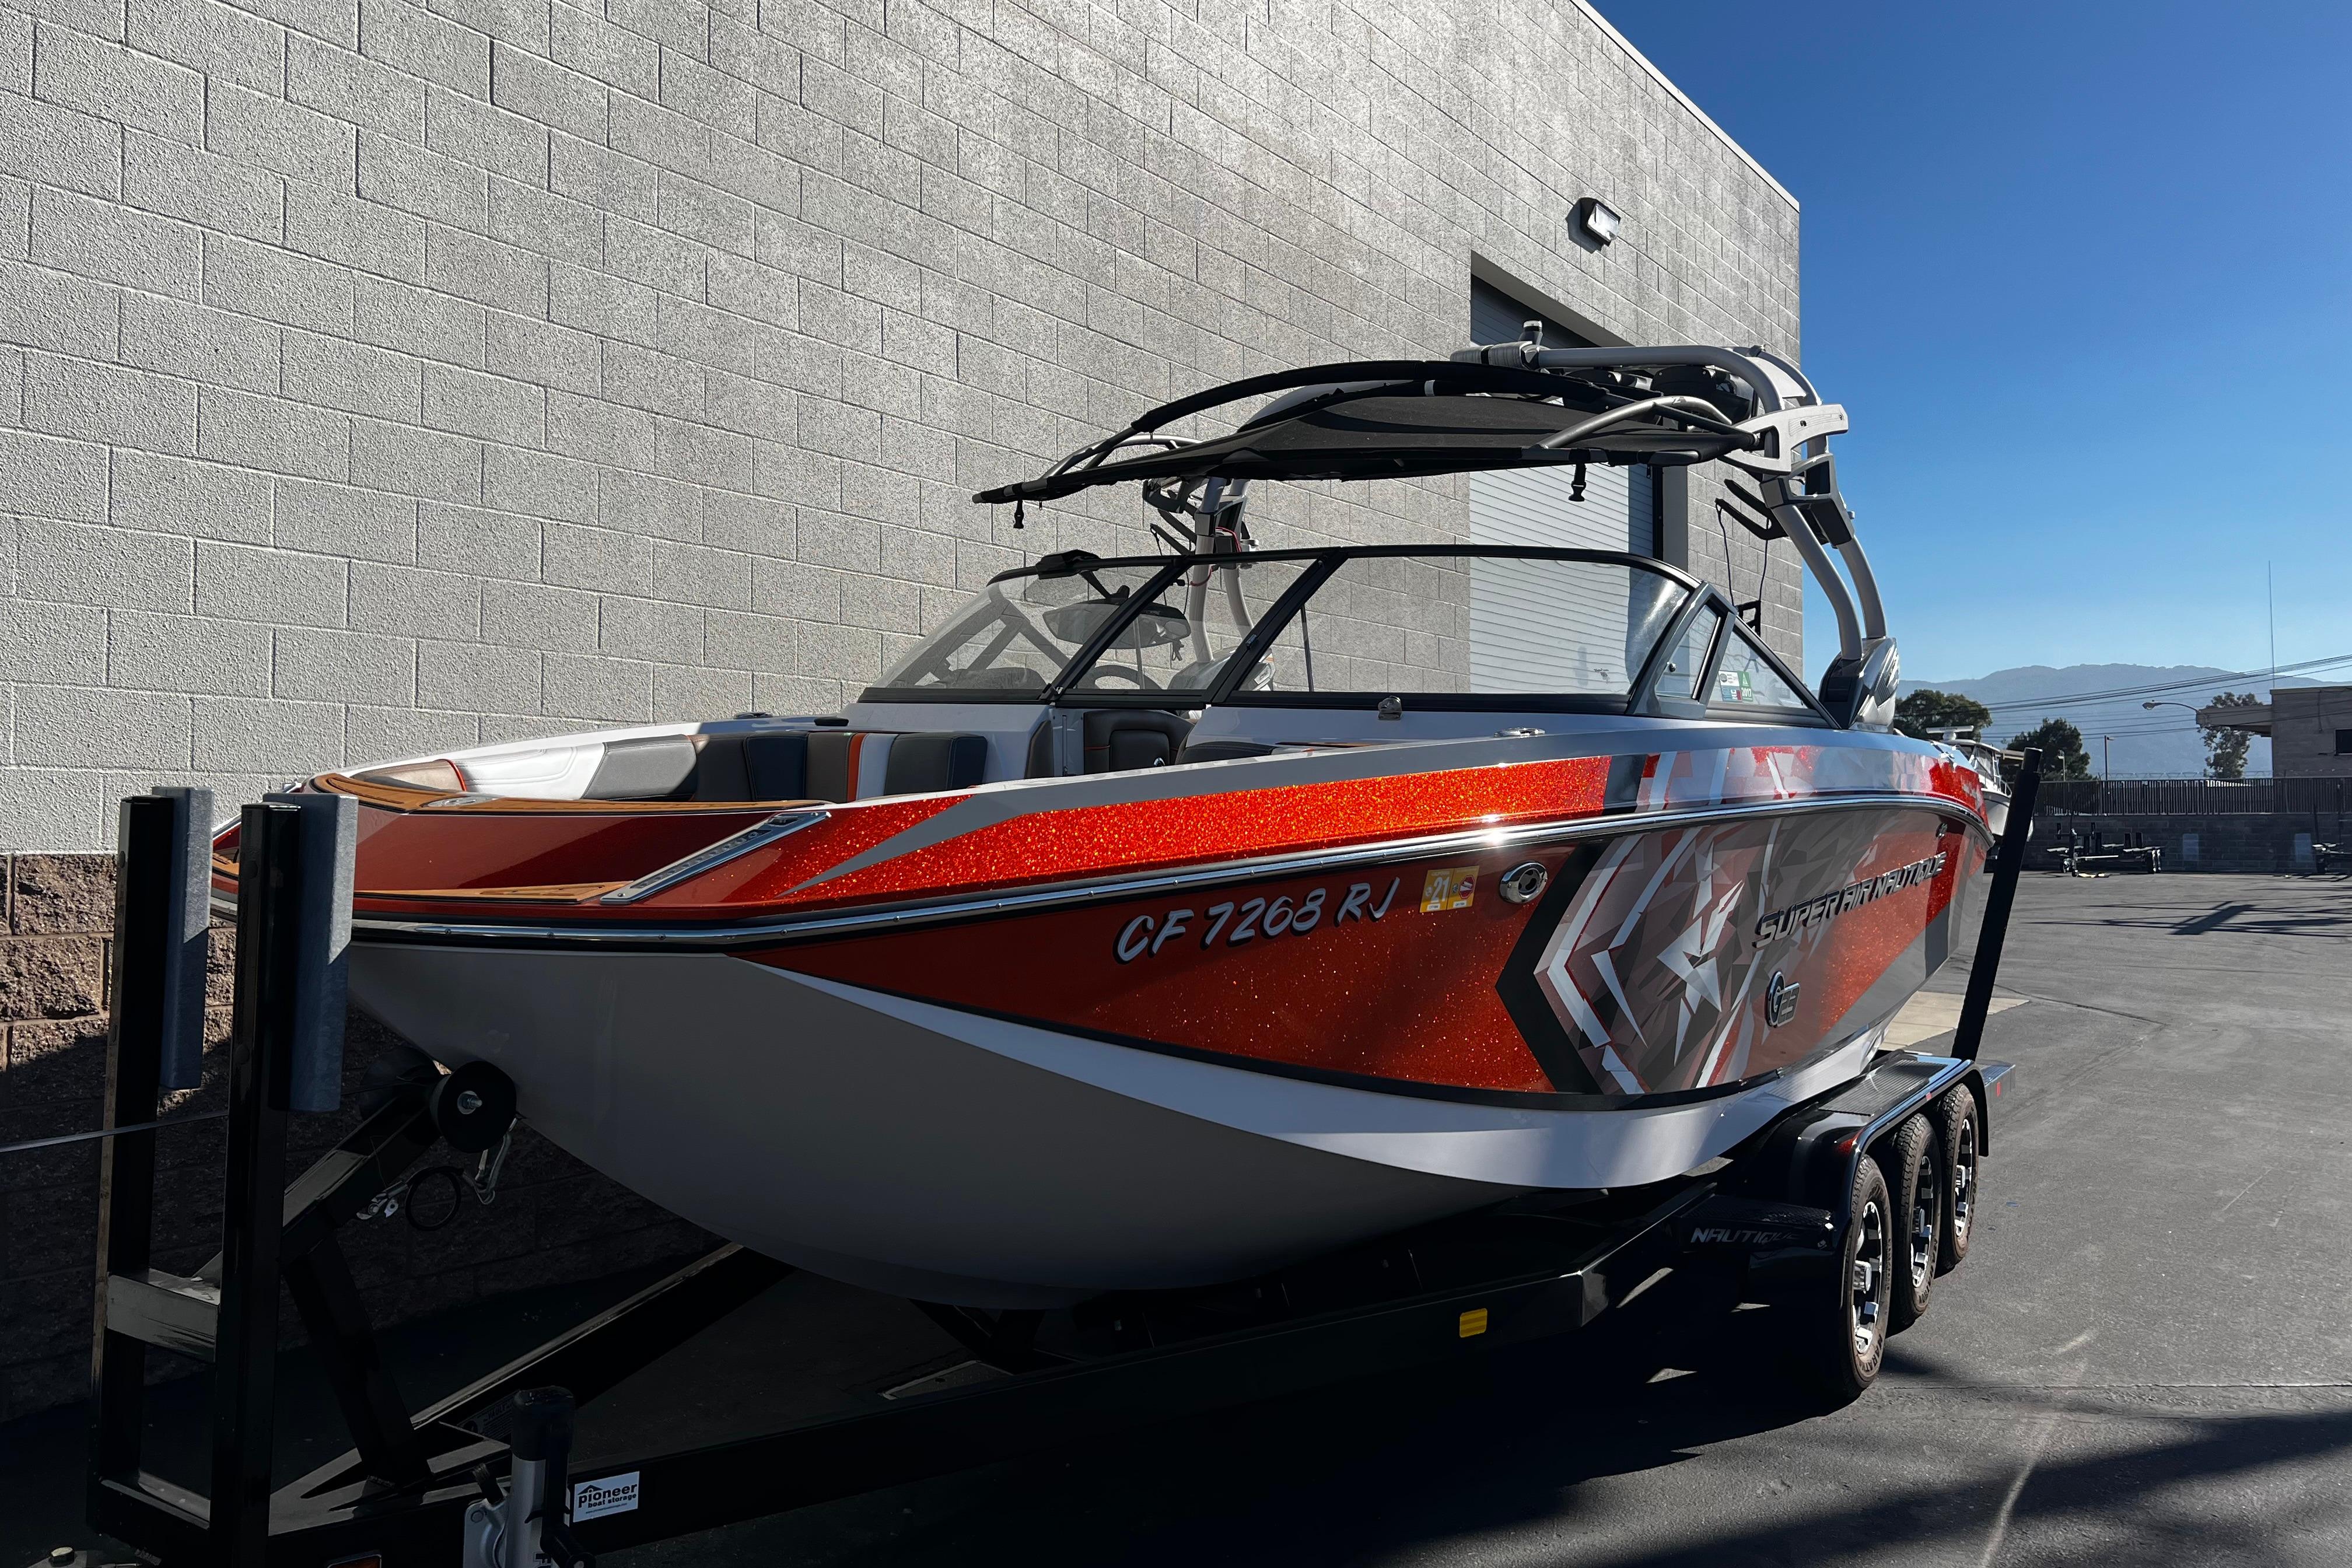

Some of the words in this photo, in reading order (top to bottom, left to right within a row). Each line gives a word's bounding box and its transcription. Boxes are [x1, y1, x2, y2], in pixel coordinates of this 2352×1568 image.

[1430, 877, 1450, 903] 21
[1752, 890, 1839, 948] SUPER
[1838, 878, 1873, 915] AIR
[1869, 852, 1947, 901] NAUTIQUE
[1114, 909, 1194, 964] CF
[1201, 887, 1327, 950] 7268
[1334, 877, 1399, 927] RJ
[578, 1484, 637, 1508] pioneer
[588, 1500, 605, 1508] boat
[608, 1494, 636, 1504] storage
